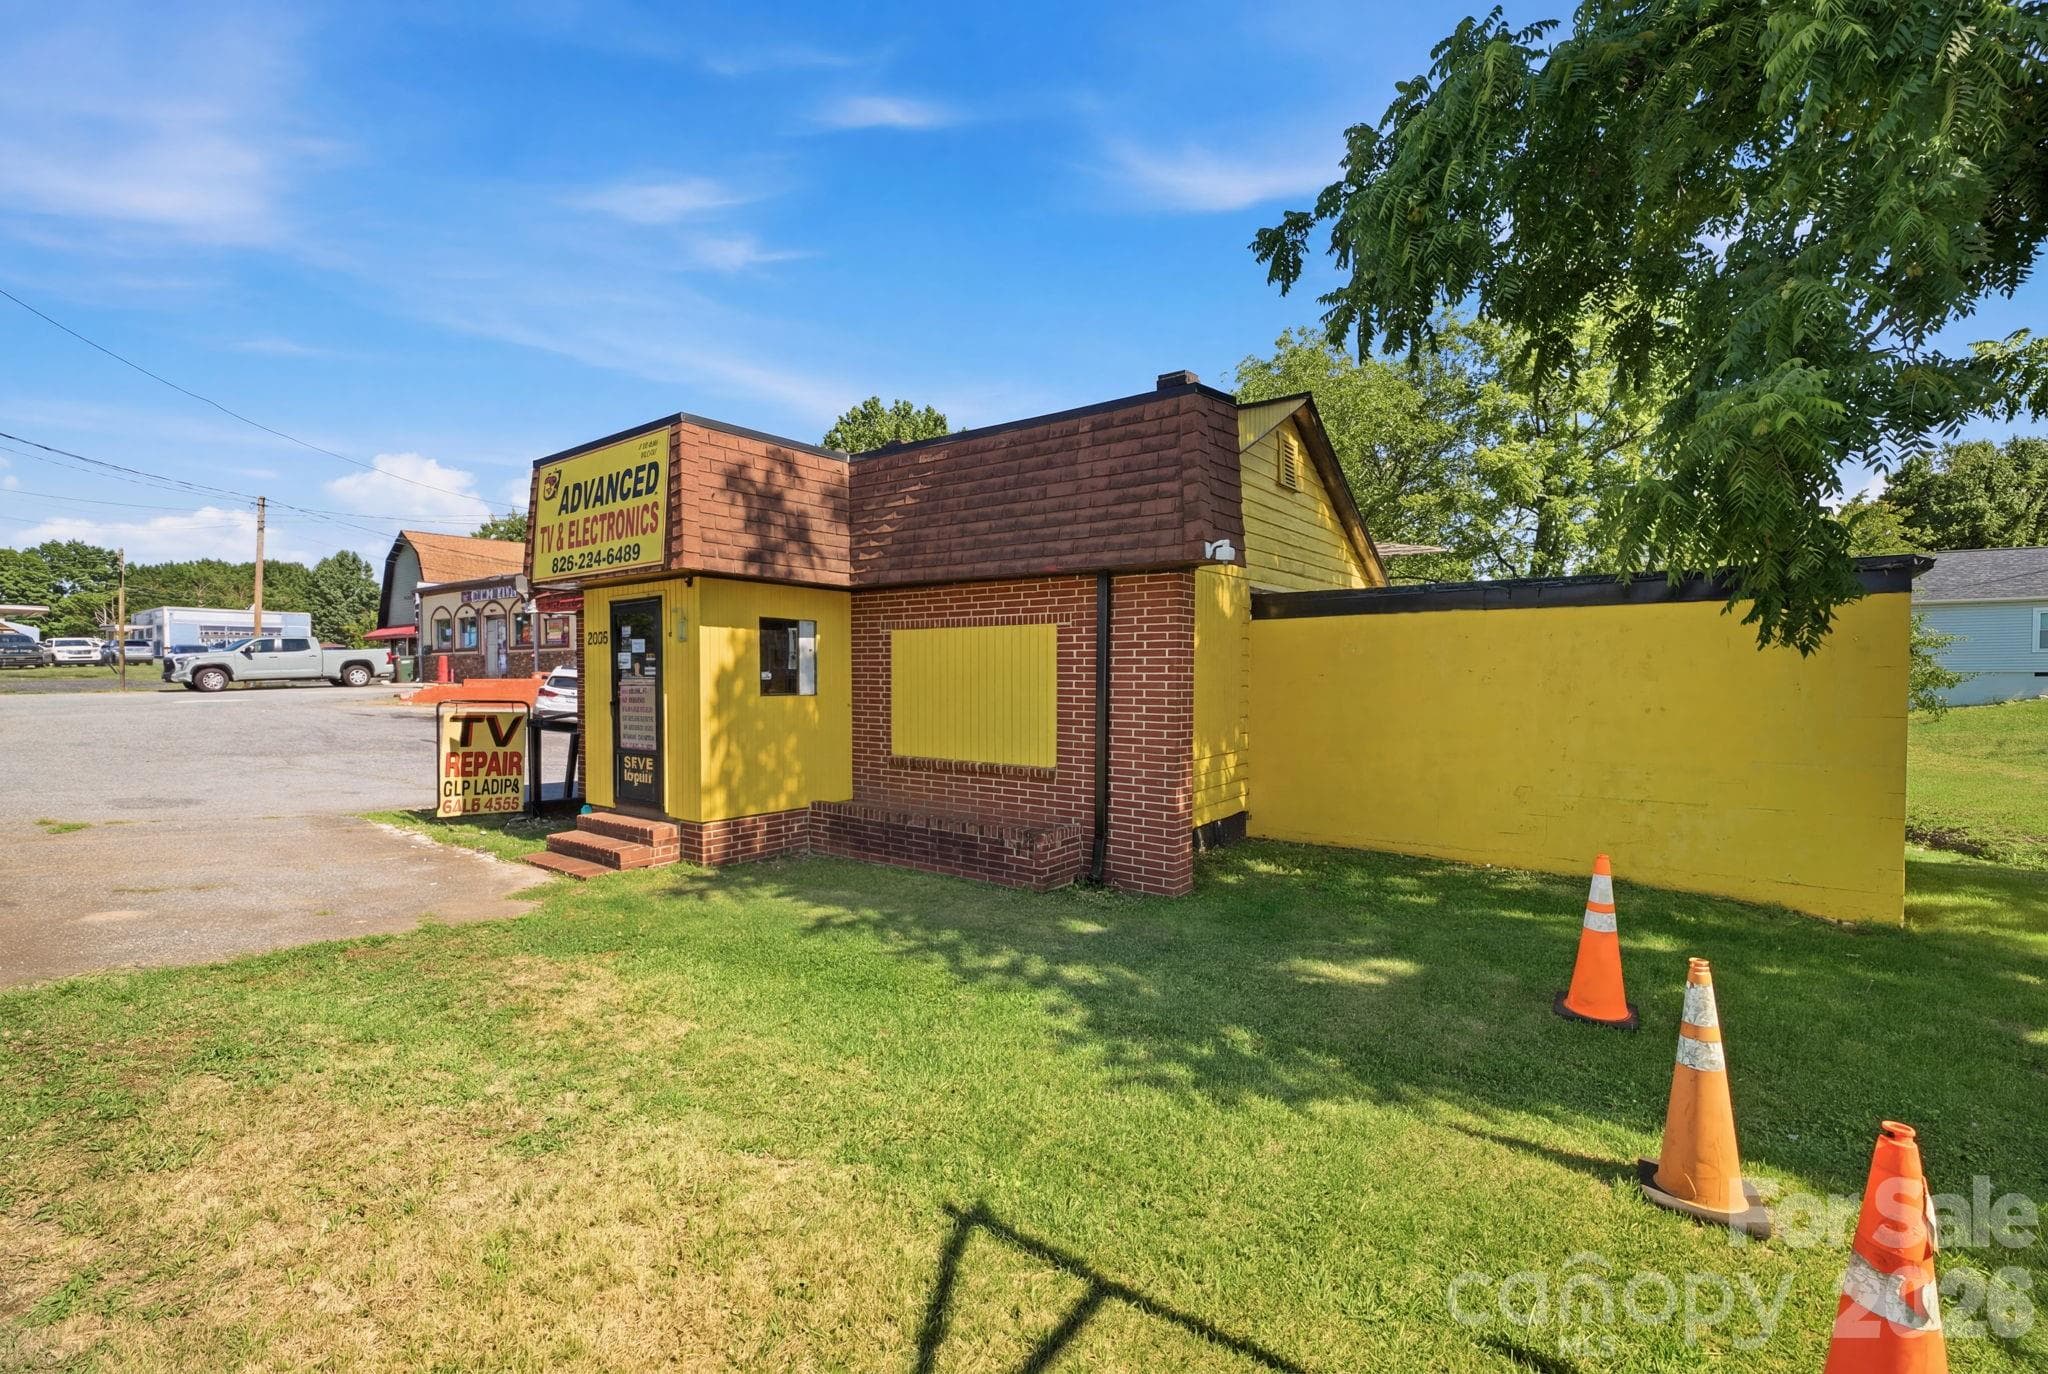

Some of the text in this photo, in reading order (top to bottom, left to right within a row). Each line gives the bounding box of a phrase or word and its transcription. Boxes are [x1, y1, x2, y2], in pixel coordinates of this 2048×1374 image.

[558, 461, 660, 516] ADVANCED
[540, 501, 660, 554] TV & ELECTRONICS
[449, 715, 525, 748] TV
[445, 751, 523, 778] REPAIR
